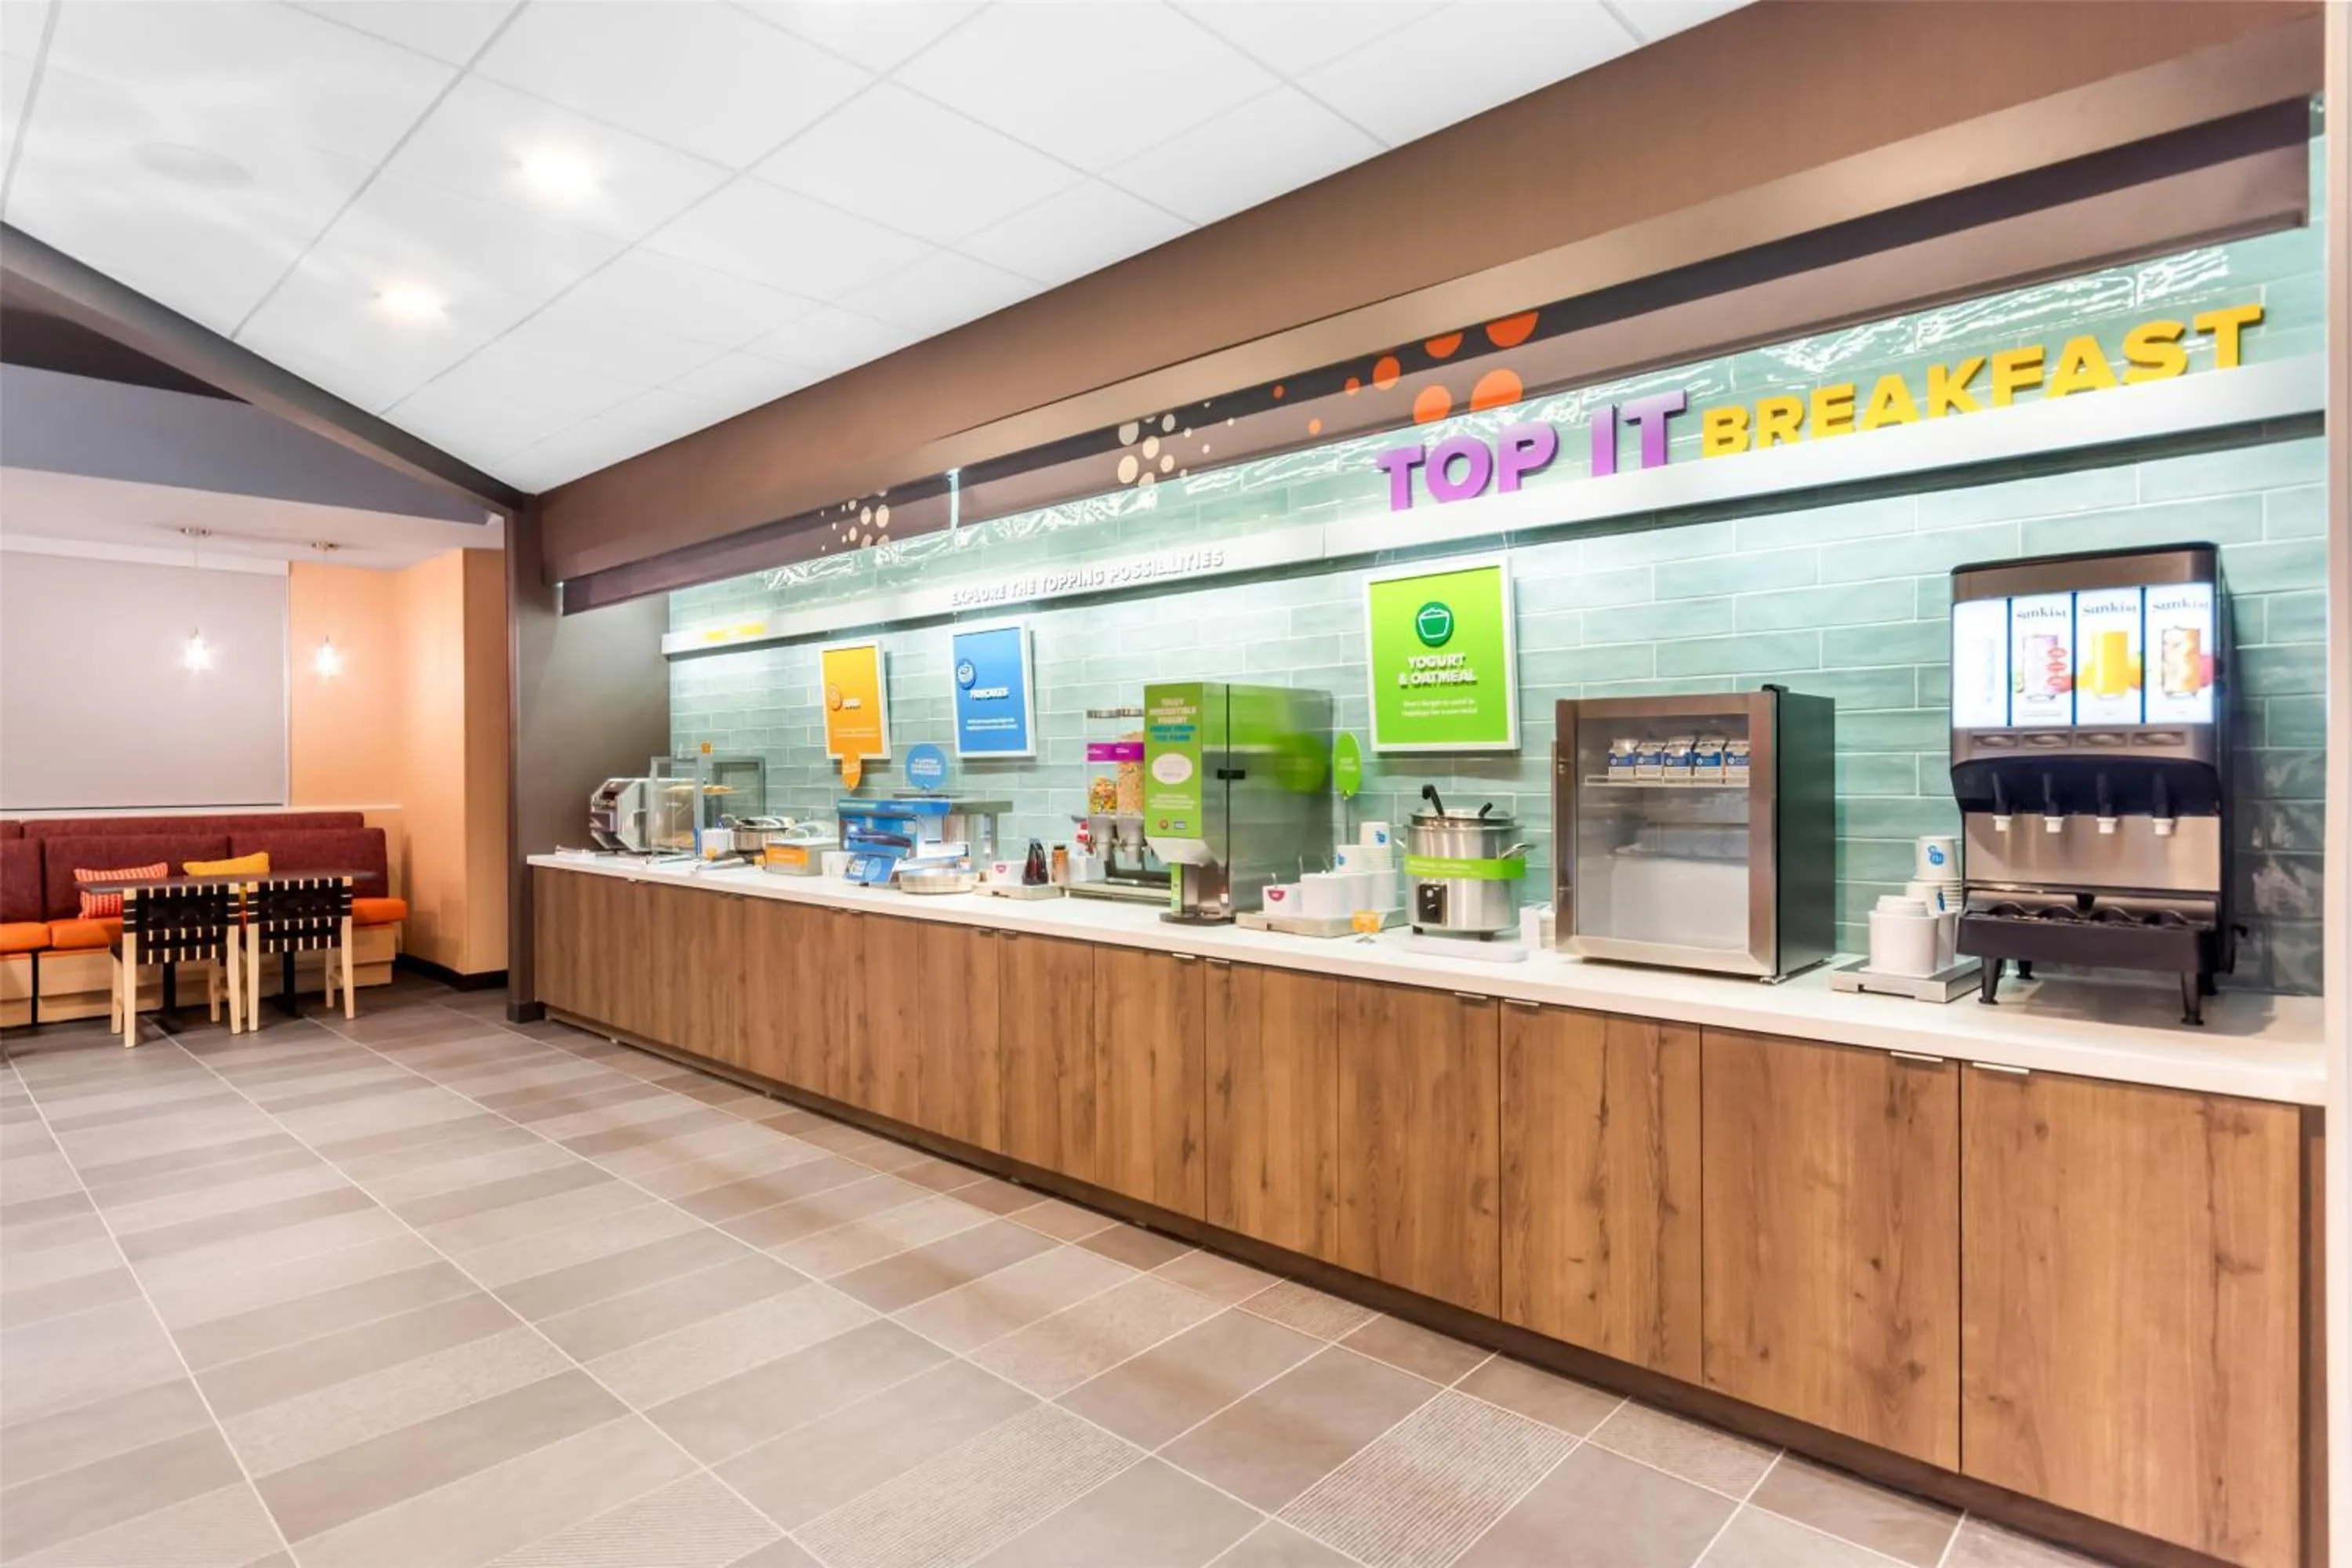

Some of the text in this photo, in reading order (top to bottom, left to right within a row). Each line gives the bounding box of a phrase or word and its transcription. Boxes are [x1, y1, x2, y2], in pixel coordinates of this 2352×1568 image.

[1377, 303, 2264, 511] TOP IT BREAKFAST
[951, 550, 1225, 606] EXPLORE THE TOPPING POSSIBILITIES
[1408, 652, 1466, 670] YOGURT
[1411, 668, 1478, 686] OATMEAL
